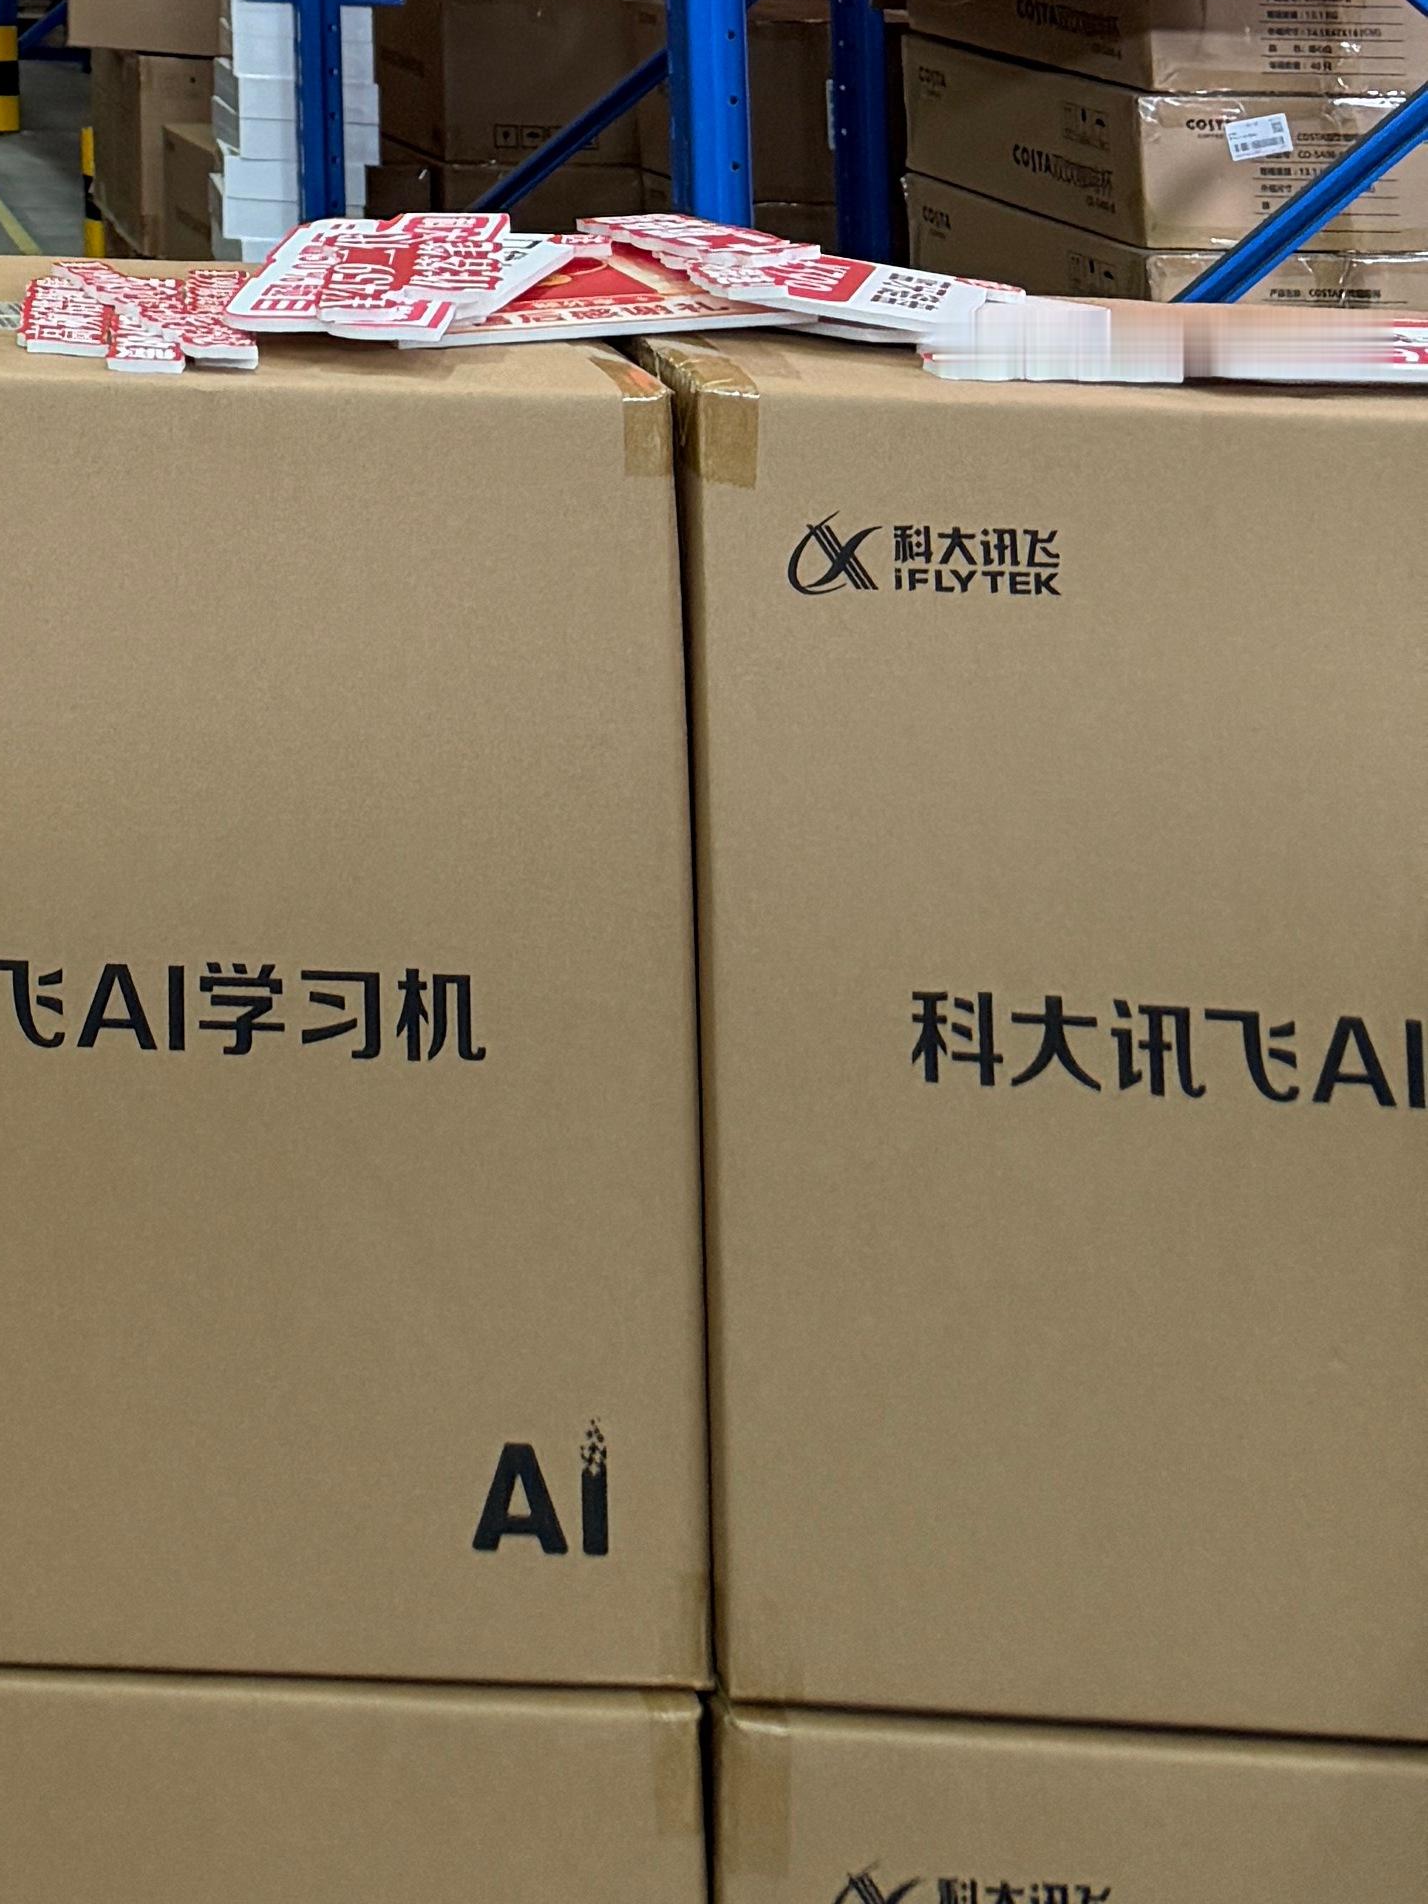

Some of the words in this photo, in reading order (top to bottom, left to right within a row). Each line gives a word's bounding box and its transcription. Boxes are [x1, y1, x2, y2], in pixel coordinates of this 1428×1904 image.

[893, 524, 1061, 569] 科大讯飞
[893, 567, 1063, 596] iFLYTEK
[910, 990, 1428, 1110] 科大讯飞AI
